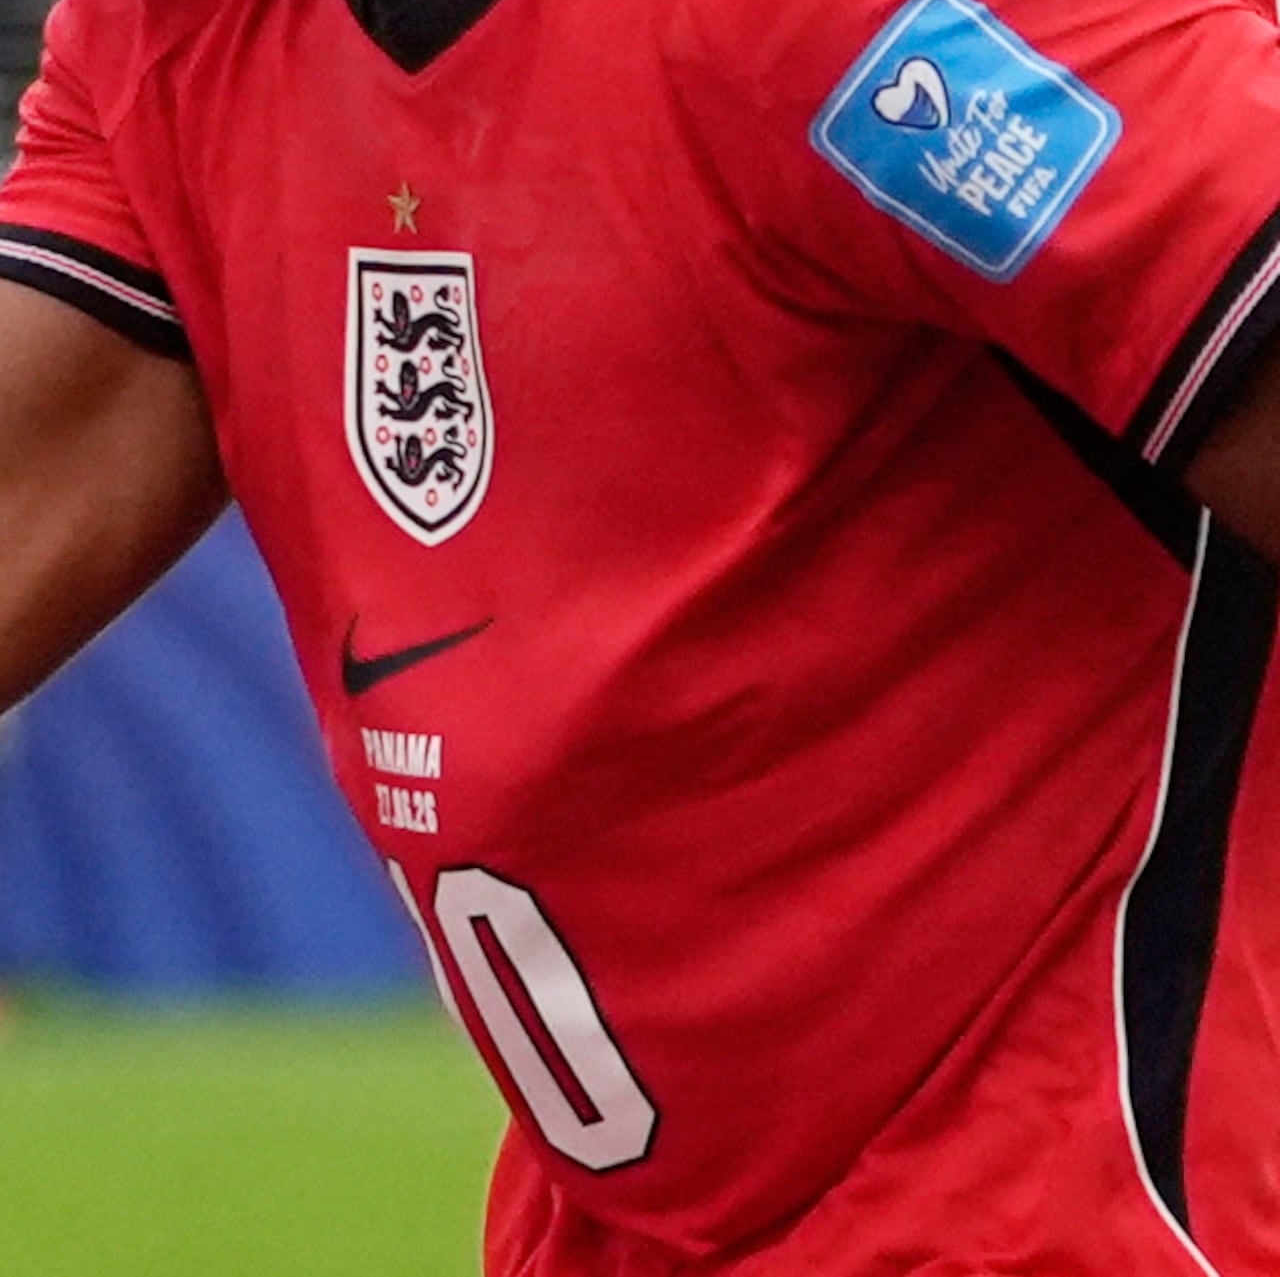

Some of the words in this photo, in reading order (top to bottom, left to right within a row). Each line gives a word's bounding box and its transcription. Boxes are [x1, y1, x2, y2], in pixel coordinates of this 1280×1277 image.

[956, 114, 1048, 217] PEACE
[1006, 167, 1058, 219] FIFA
[360, 727, 443, 780] PANAMA
